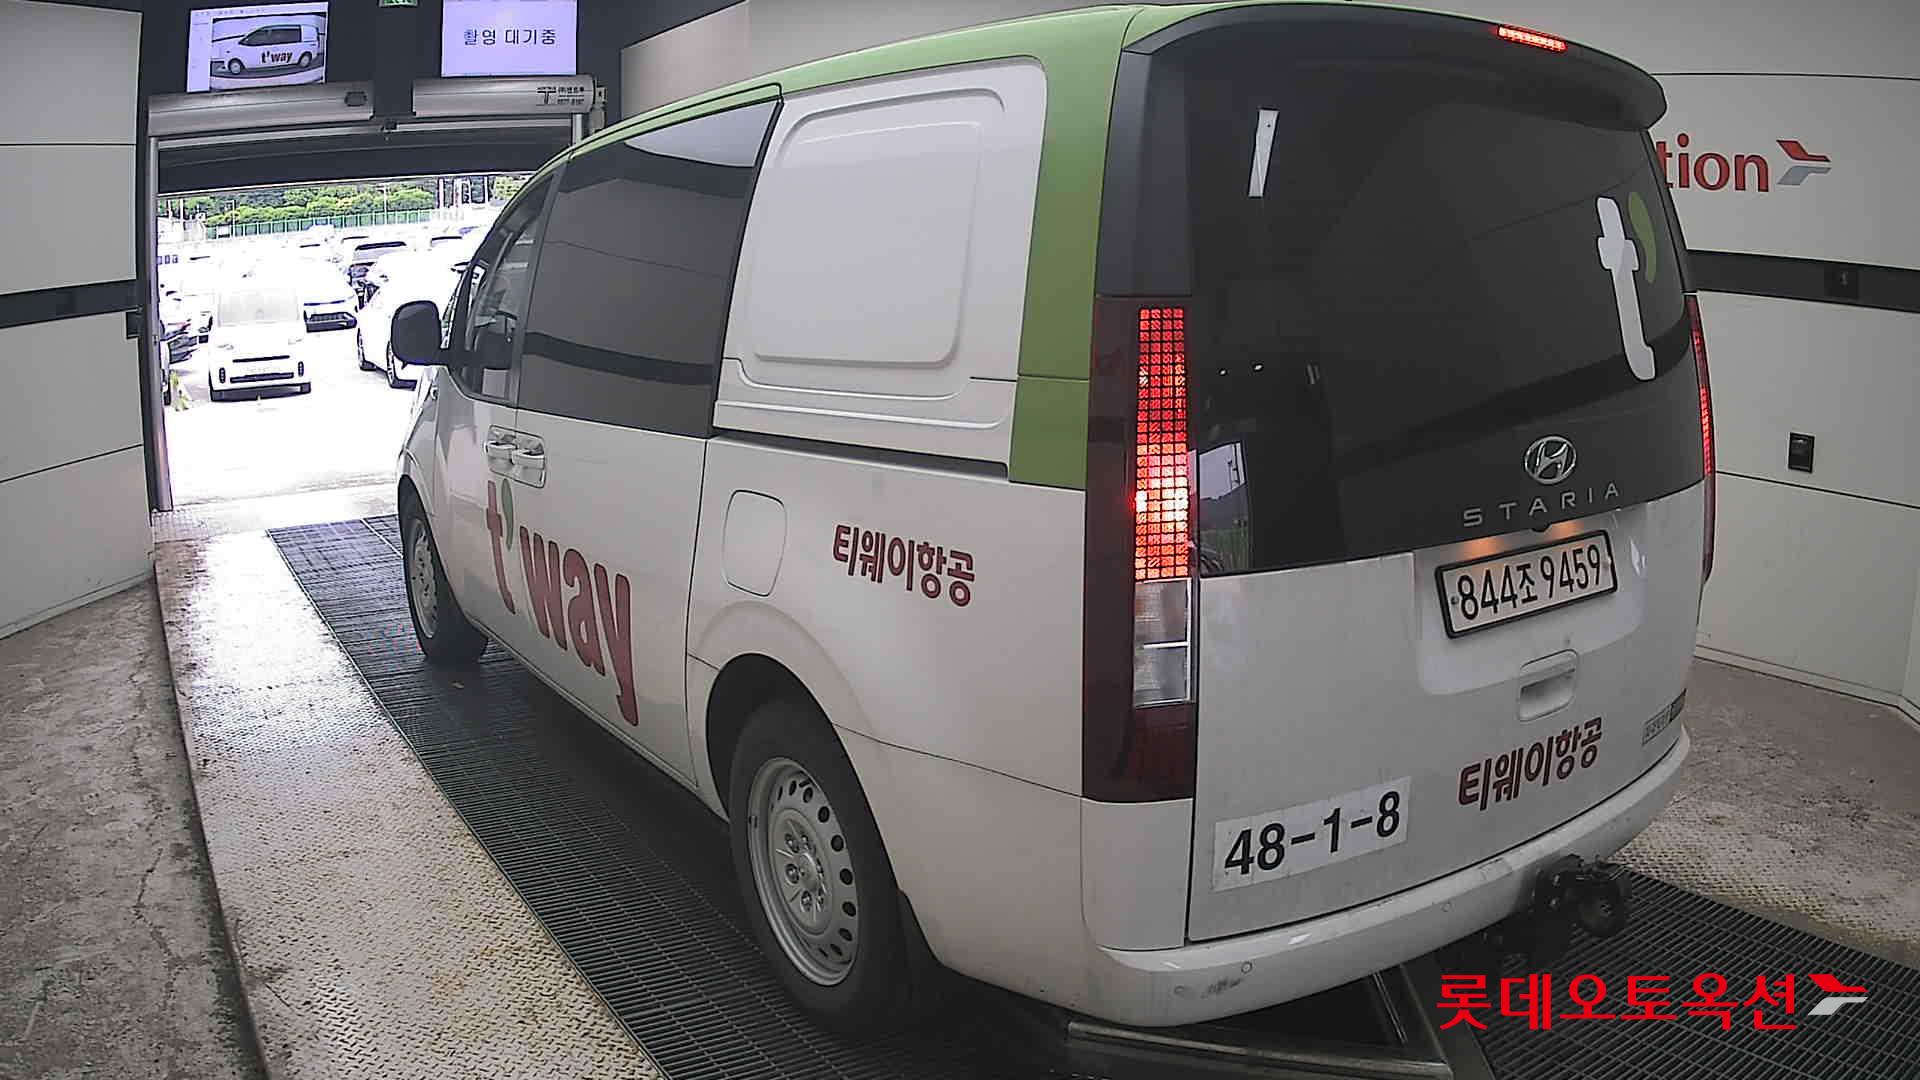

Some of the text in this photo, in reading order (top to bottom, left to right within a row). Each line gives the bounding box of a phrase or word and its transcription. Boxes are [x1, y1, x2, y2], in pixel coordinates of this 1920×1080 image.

[504, 28, 556, 45] 대기중
[1463, 482, 1620, 528] STARIA
[833, 524, 976, 607] 티웨이항공
[1458, 716, 1603, 811] 티웨이항공
[1224, 791, 1401, 875] 48-1-8
